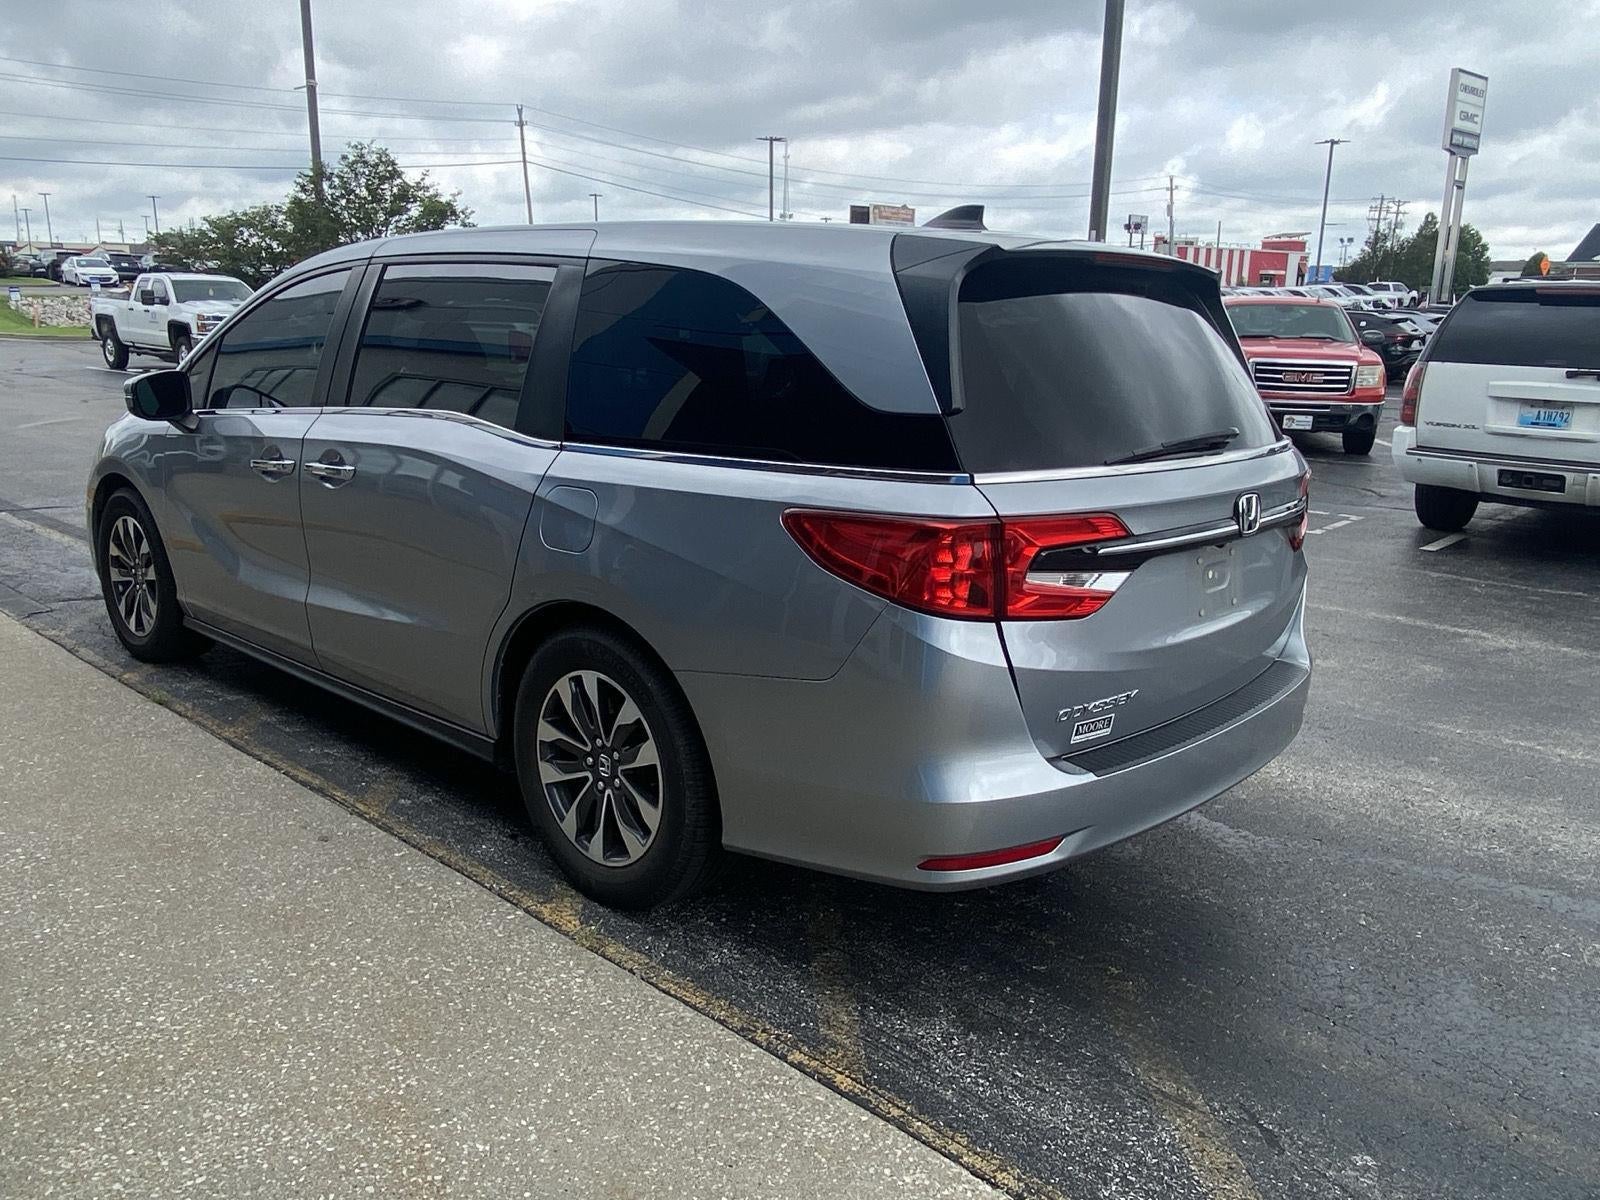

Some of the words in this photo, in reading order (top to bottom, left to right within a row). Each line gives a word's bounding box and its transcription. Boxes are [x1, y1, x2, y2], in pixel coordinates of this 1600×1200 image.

[1459, 110, 1479, 125] GMC
[1281, 371, 1325, 383] GMC
[1056, 688, 1139, 722] ODYSSEY
[1076, 717, 1111, 735] MOORE
